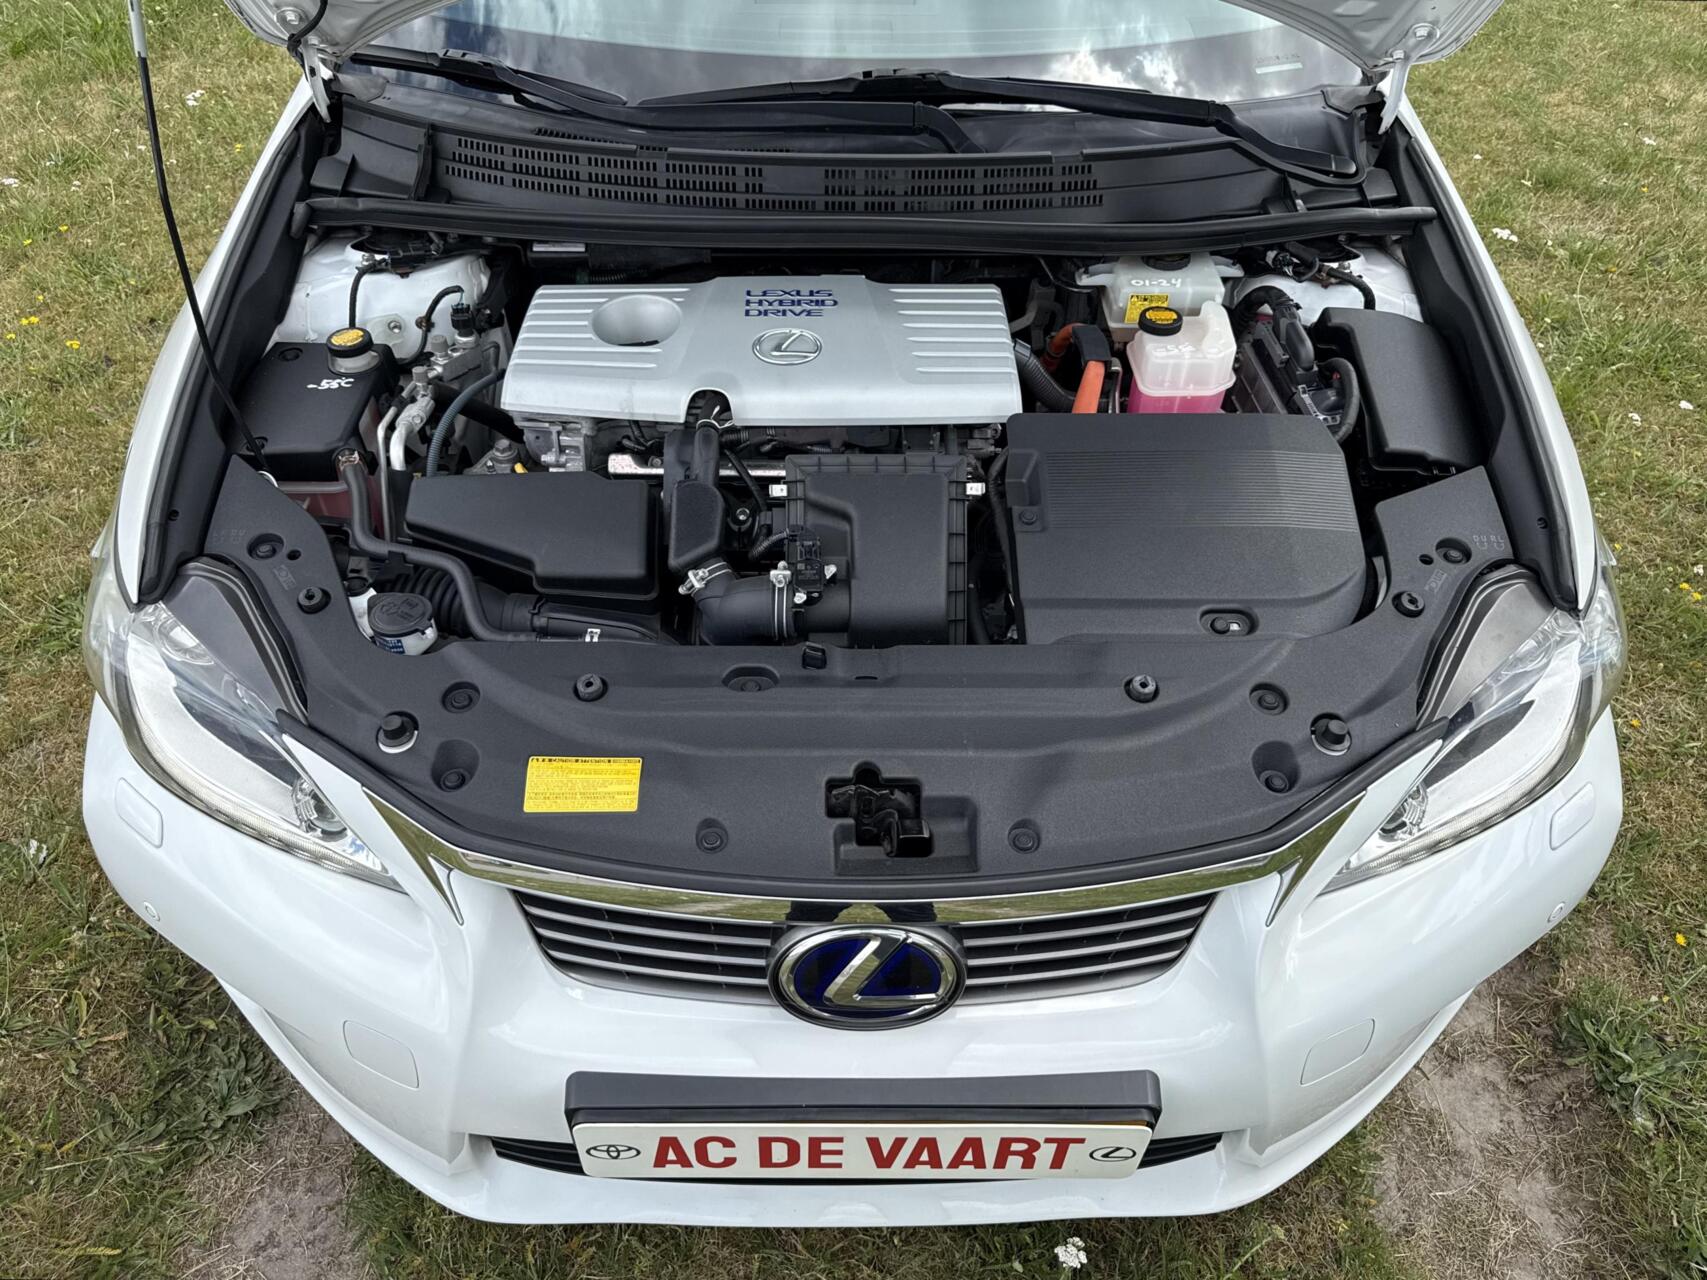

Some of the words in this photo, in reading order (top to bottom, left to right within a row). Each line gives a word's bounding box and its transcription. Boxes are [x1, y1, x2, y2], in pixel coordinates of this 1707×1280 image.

[1131, 278, 1182, 288] 01-24
[746, 289, 833, 298] LEXUS
[745, 299, 839, 307] HYBRID
[744, 308, 825, 317] DRIVE
[652, 1136, 736, 1168] AC
[758, 1137, 843, 1168] DE
[866, 1137, 1086, 1169] VAART
